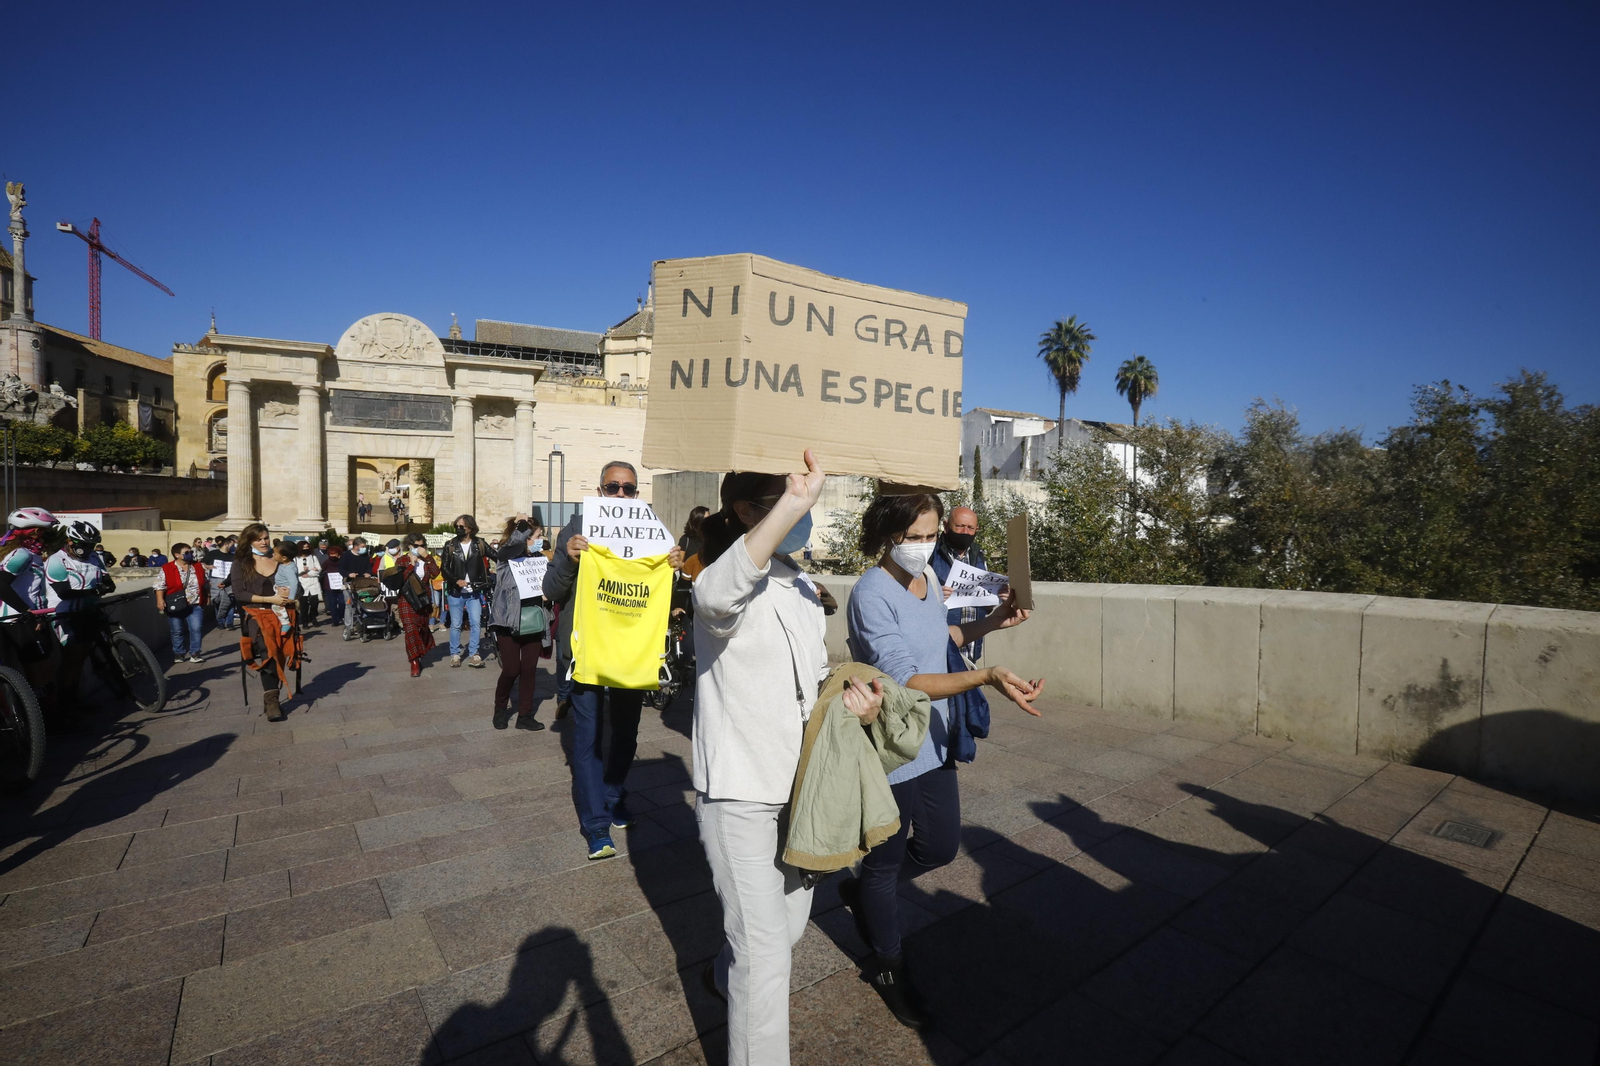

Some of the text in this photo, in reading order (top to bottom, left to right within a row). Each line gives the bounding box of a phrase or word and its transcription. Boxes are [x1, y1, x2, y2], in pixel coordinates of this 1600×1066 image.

[682, 285, 740, 318] NI
[768, 291, 835, 336] UN
[670, 358, 710, 390] NI
[725, 357, 804, 397] UNA
[598, 505, 624, 519] NO
[588, 525, 667, 541] PLANETA
[623, 546, 634, 558] B
[598, 578, 650, 598] AMNISTÍA
[597, 592, 648, 608] INTERNACIONAL
